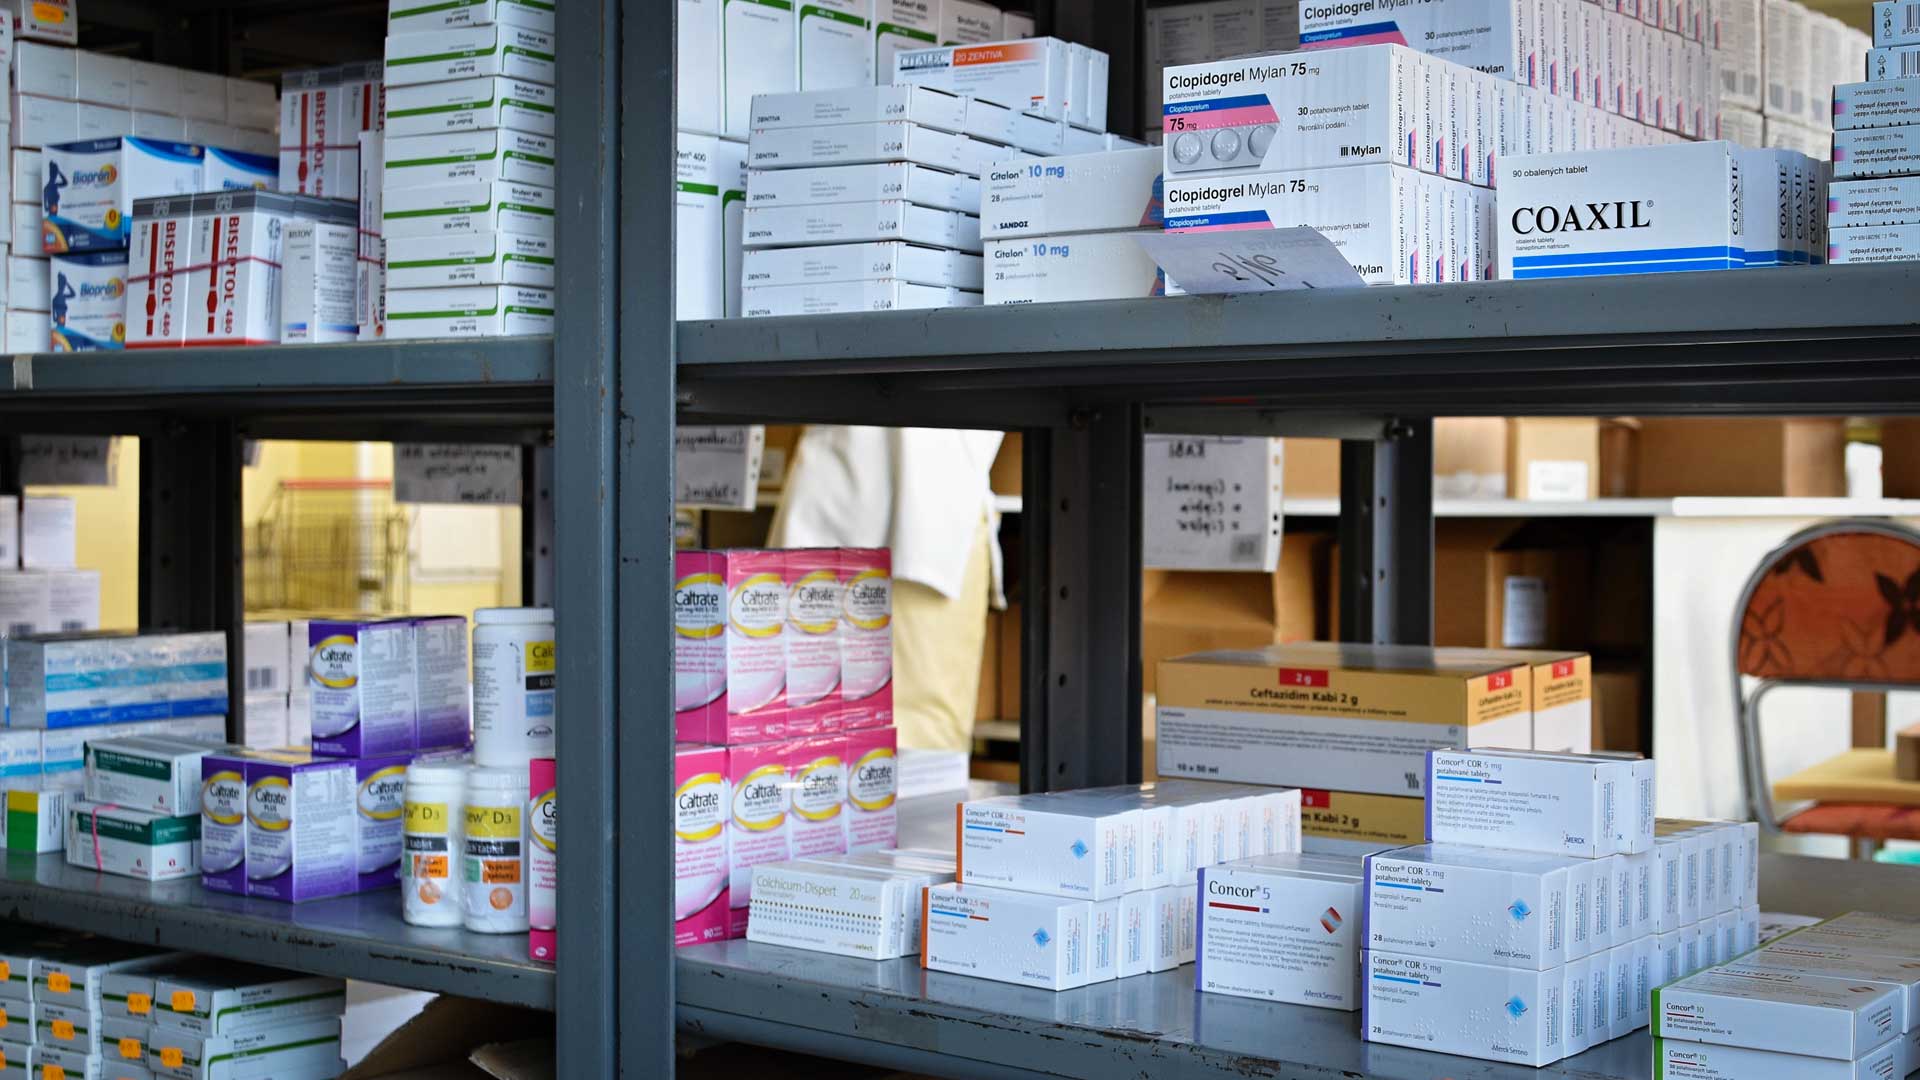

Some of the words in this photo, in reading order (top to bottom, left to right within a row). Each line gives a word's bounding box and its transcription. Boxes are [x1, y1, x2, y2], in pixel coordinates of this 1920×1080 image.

[1304, 0, 1375, 20] Clopidogrel
[1425, 32, 1435, 40] 30
[1169, 68, 1245, 93] Clopidogrel
[1250, 64, 1286, 82] Mylan
[1290, 62, 1307, 77] 75
[1308, 66, 1320, 76] mg
[1168, 89, 1202, 100] potahované
[1202, 87, 1222, 97] tablety
[1168, 103, 1210, 114] Clopidogrelum
[1297, 106, 1308, 116] 30
[1309, 105, 1351, 116] potahovaných
[1352, 103, 1370, 112] tablet
[1170, 118, 1185, 131] 75
[1186, 122, 1198, 131] mg
[1326, 120, 1347, 131] podání
[1351, 145, 1381, 158] Mylan
[1028, 165, 1042, 178] 10
[1045, 165, 1065, 178] mg
[1523, 166, 1563, 178] obalených
[1565, 164, 1588, 175] tablet
[991, 194, 1000, 203] 28
[1168, 184, 1245, 208] Clopidogrel
[1248, 181, 1286, 199] Mylan
[1290, 179, 1306, 193] 75
[1307, 183, 1319, 193] mg
[1168, 204, 1201, 214] potahované
[1202, 203, 1221, 212] tablety
[999, 221, 1028, 229] SANDOZ
[1168, 217, 1210, 228] Clopidogrelum
[1352, 221, 1370, 230] tablet
[1537, 236, 1555, 245] tablety
[1033, 244, 1047, 256] 10
[1050, 244, 1070, 257] mg
[162, 221, 176, 305] BISEPTOL
[223, 216, 239, 303] BISEPTOL
[995, 272, 1005, 280] 28
[1353, 264, 1384, 276] Mylan
[162, 311, 171, 336] 480
[224, 309, 233, 334] 480
[675, 589, 718, 606] Caltrate
[741, 590, 779, 606] Caltrate
[799, 587, 835, 602] Caltrate
[852, 584, 886, 600] Caltrate
[320, 647, 352, 662] Caltrate
[1250, 688, 1310, 703] Ceftazidim
[1312, 691, 1338, 703] Kabi
[1340, 693, 1348, 703] 2
[1350, 696, 1359, 706] g
[1466, 759, 1482, 768] COR
[1490, 763, 1502, 771] mg
[858, 764, 891, 781] Caltrate
[1436, 767, 1469, 776] potahované
[1470, 770, 1491, 778] tablety
[209, 782, 240, 800] Caltrate
[255, 788, 287, 806] Caltrate
[744, 784, 782, 800] Caltrate
[679, 792, 719, 810] Caltrate
[1314, 812, 1338, 825] Kabi
[1341, 815, 1348, 826] 2
[1352, 818, 1360, 829] g
[1407, 866, 1423, 875] COR
[1425, 868, 1431, 876] 5
[1432, 870, 1445, 879] mg
[1375, 873, 1410, 883] potahované
[1411, 877, 1432, 886] tablety
[756, 875, 837, 897] Colchicum-Dispert
[849, 887, 861, 900] 20
[1262, 887, 1271, 900] 5
[956, 897, 968, 905] COR
[1404, 960, 1421, 969] COR
[1422, 962, 1428, 970] 5
[1429, 965, 1442, 974] mg
[1373, 967, 1408, 977] potahované
[1408, 971, 1430, 981] tablety
[1696, 1005, 1704, 1013] 10
[1372, 1026, 1382, 1034] 28
[1699, 1053, 1707, 1062] 10
